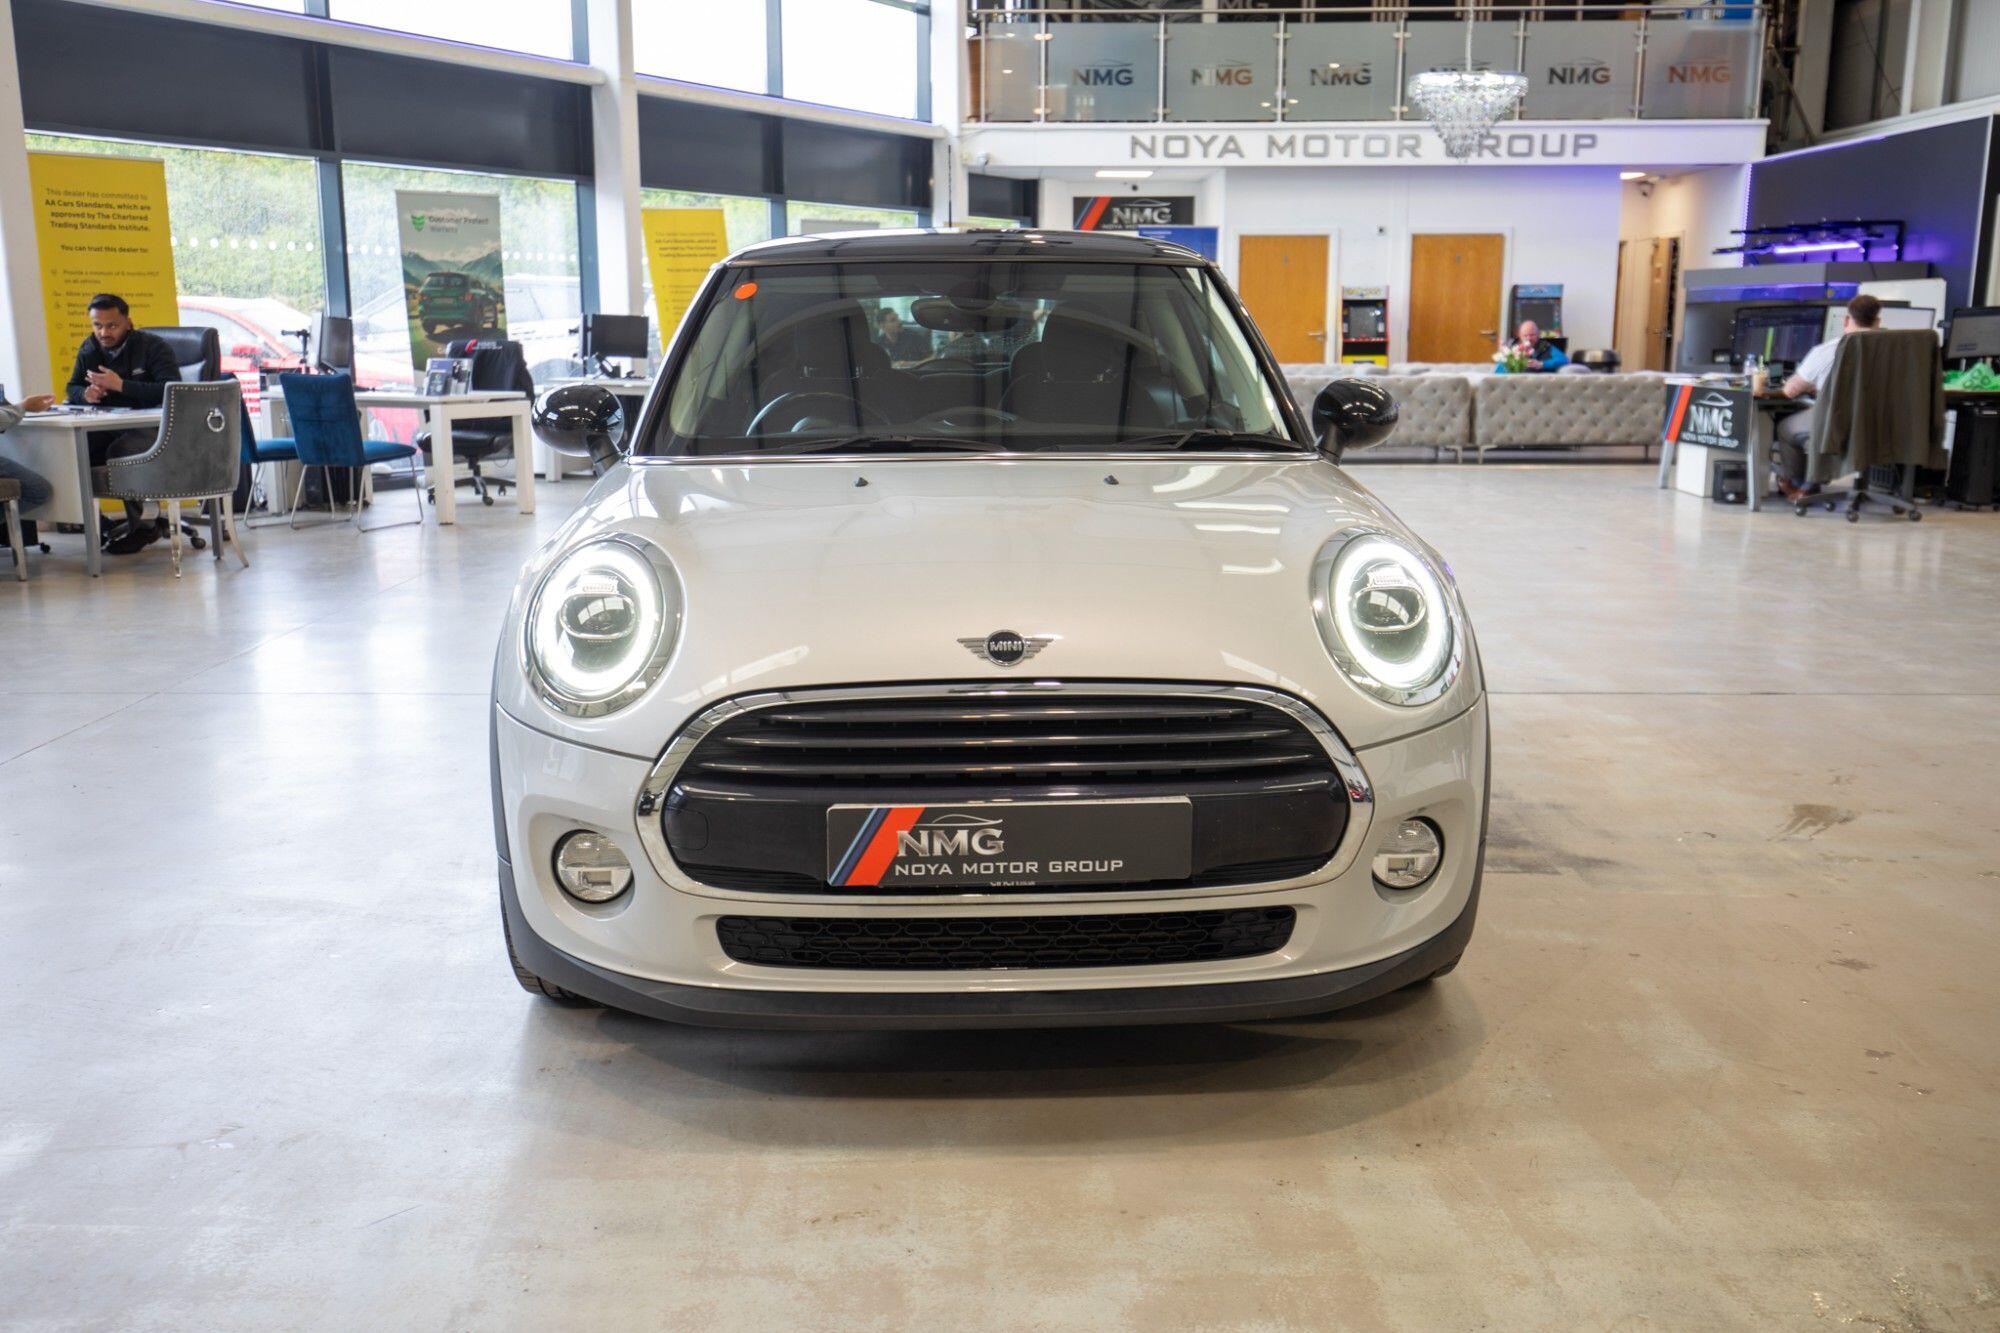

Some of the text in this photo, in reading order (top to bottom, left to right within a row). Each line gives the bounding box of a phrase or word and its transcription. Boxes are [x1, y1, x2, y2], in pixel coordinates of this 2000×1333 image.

[1072, 68, 1133, 86] NMG
[1191, 68, 1252, 86] NMG
[1310, 67, 1371, 86] NMG
[1549, 67, 1611, 84] NMG
[1669, 66, 1731, 84] NMG
[1131, 135, 1245, 158] NOYA
[1267, 134, 1422, 158] MOTOR
[46, 187, 62, 196] This
[57, 199, 74, 208] Cars
[75, 200, 115, 210] Standards,
[117, 202, 137, 211] which
[50, 211, 148, 221] approved by The Chartered
[1111, 206, 1172, 224] NMG
[50, 221, 79, 230] Trading
[79, 222, 117, 231] Standards
[1689, 405, 1733, 437] NMG
[989, 640, 1023, 652] MINI
[896, 827, 1005, 858] NMG
[894, 859, 1125, 877] NOYA MOTOR GROUP
